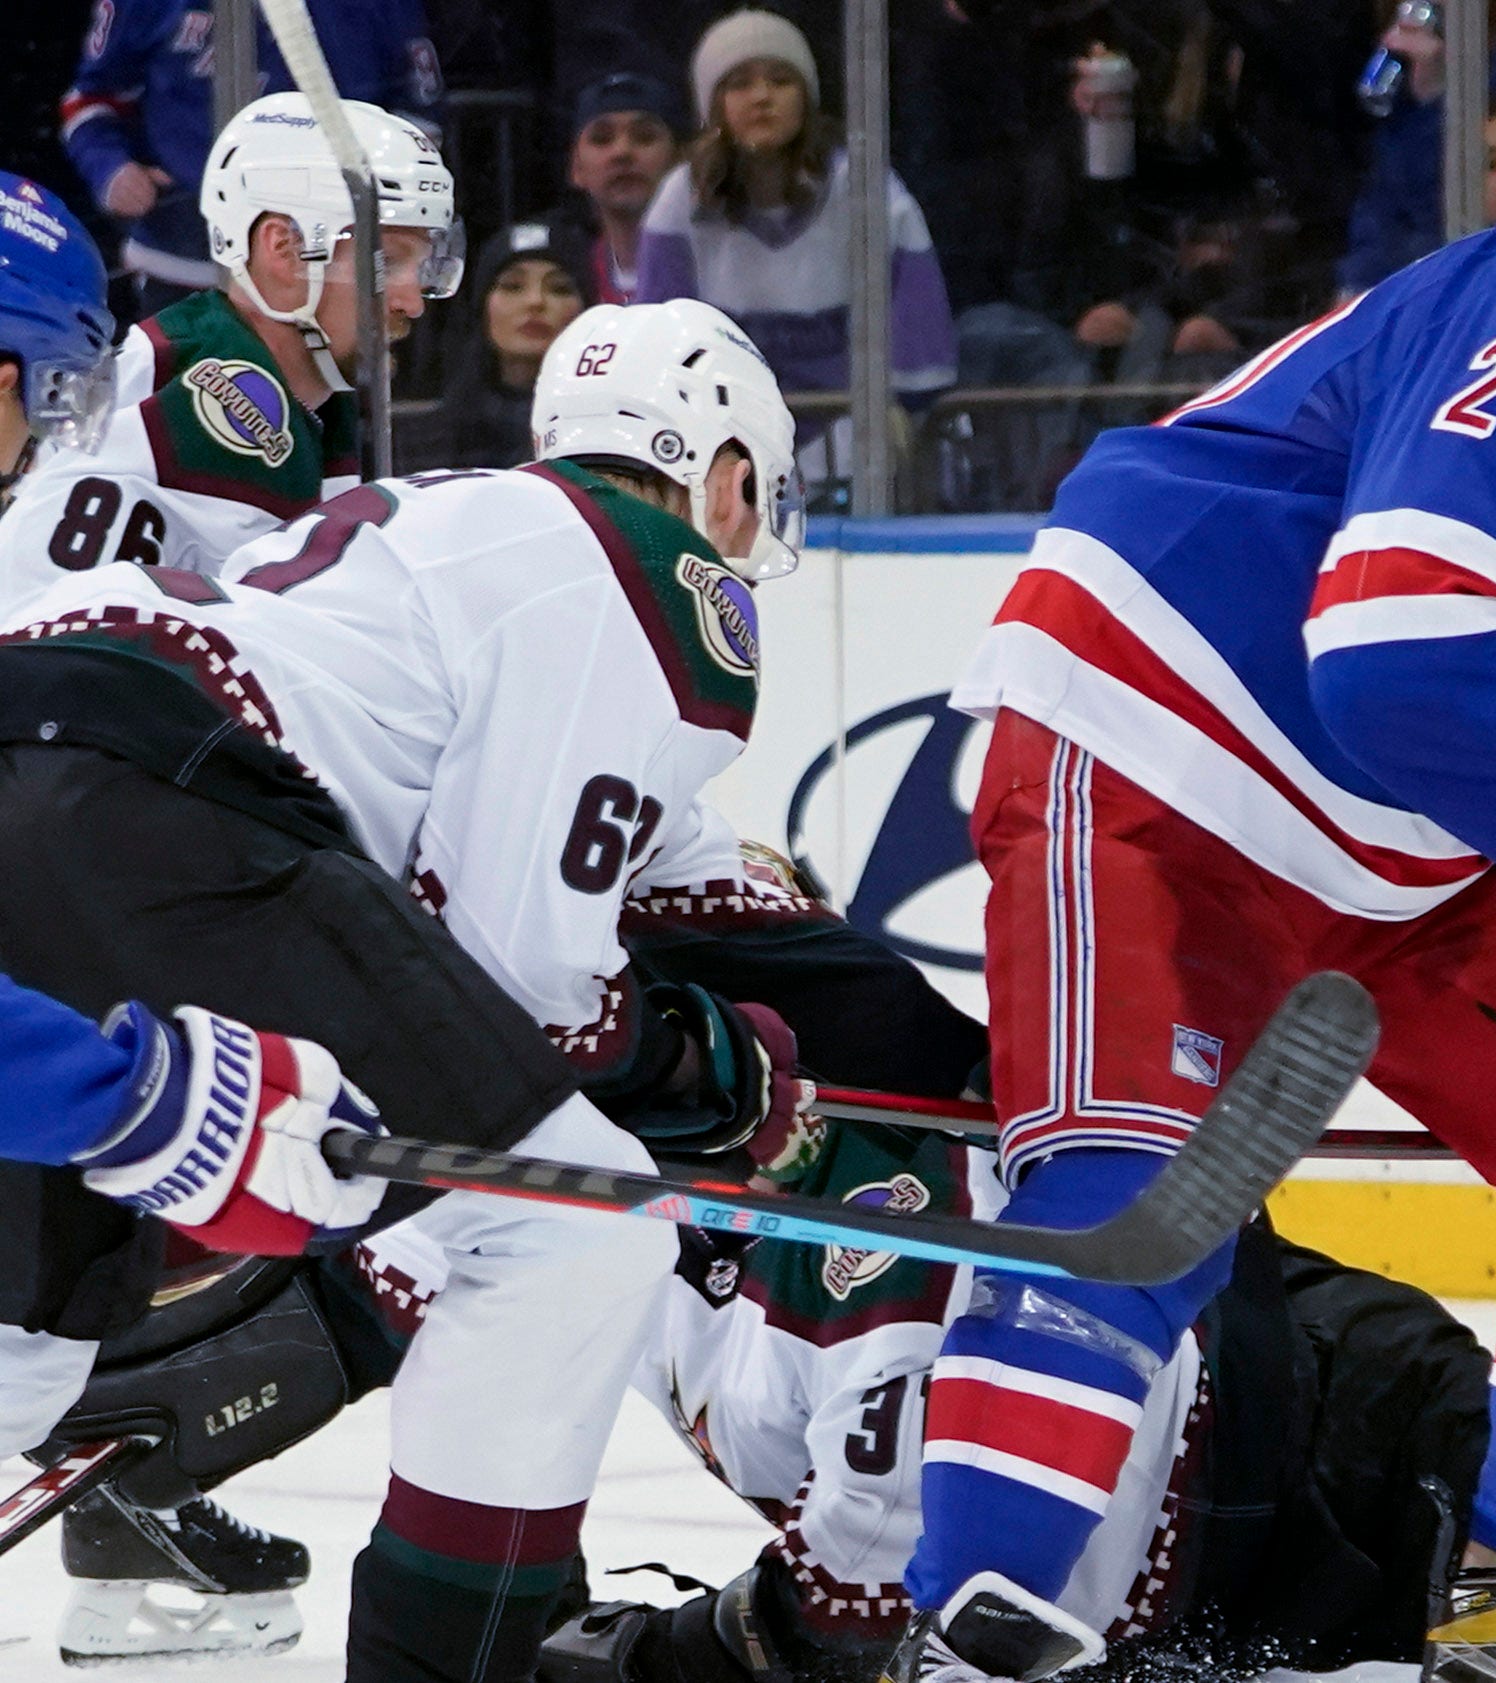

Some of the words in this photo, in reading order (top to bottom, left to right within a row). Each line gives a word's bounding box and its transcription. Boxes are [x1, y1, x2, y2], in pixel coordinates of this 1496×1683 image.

[3, 211, 59, 253] Moore
[575, 343, 618, 378] 62
[187, 361, 291, 462] COYOTES
[48, 476, 166, 572] 86
[756, 1216, 781, 1233] 10
[205, 1382, 280, 1437] L12.2
